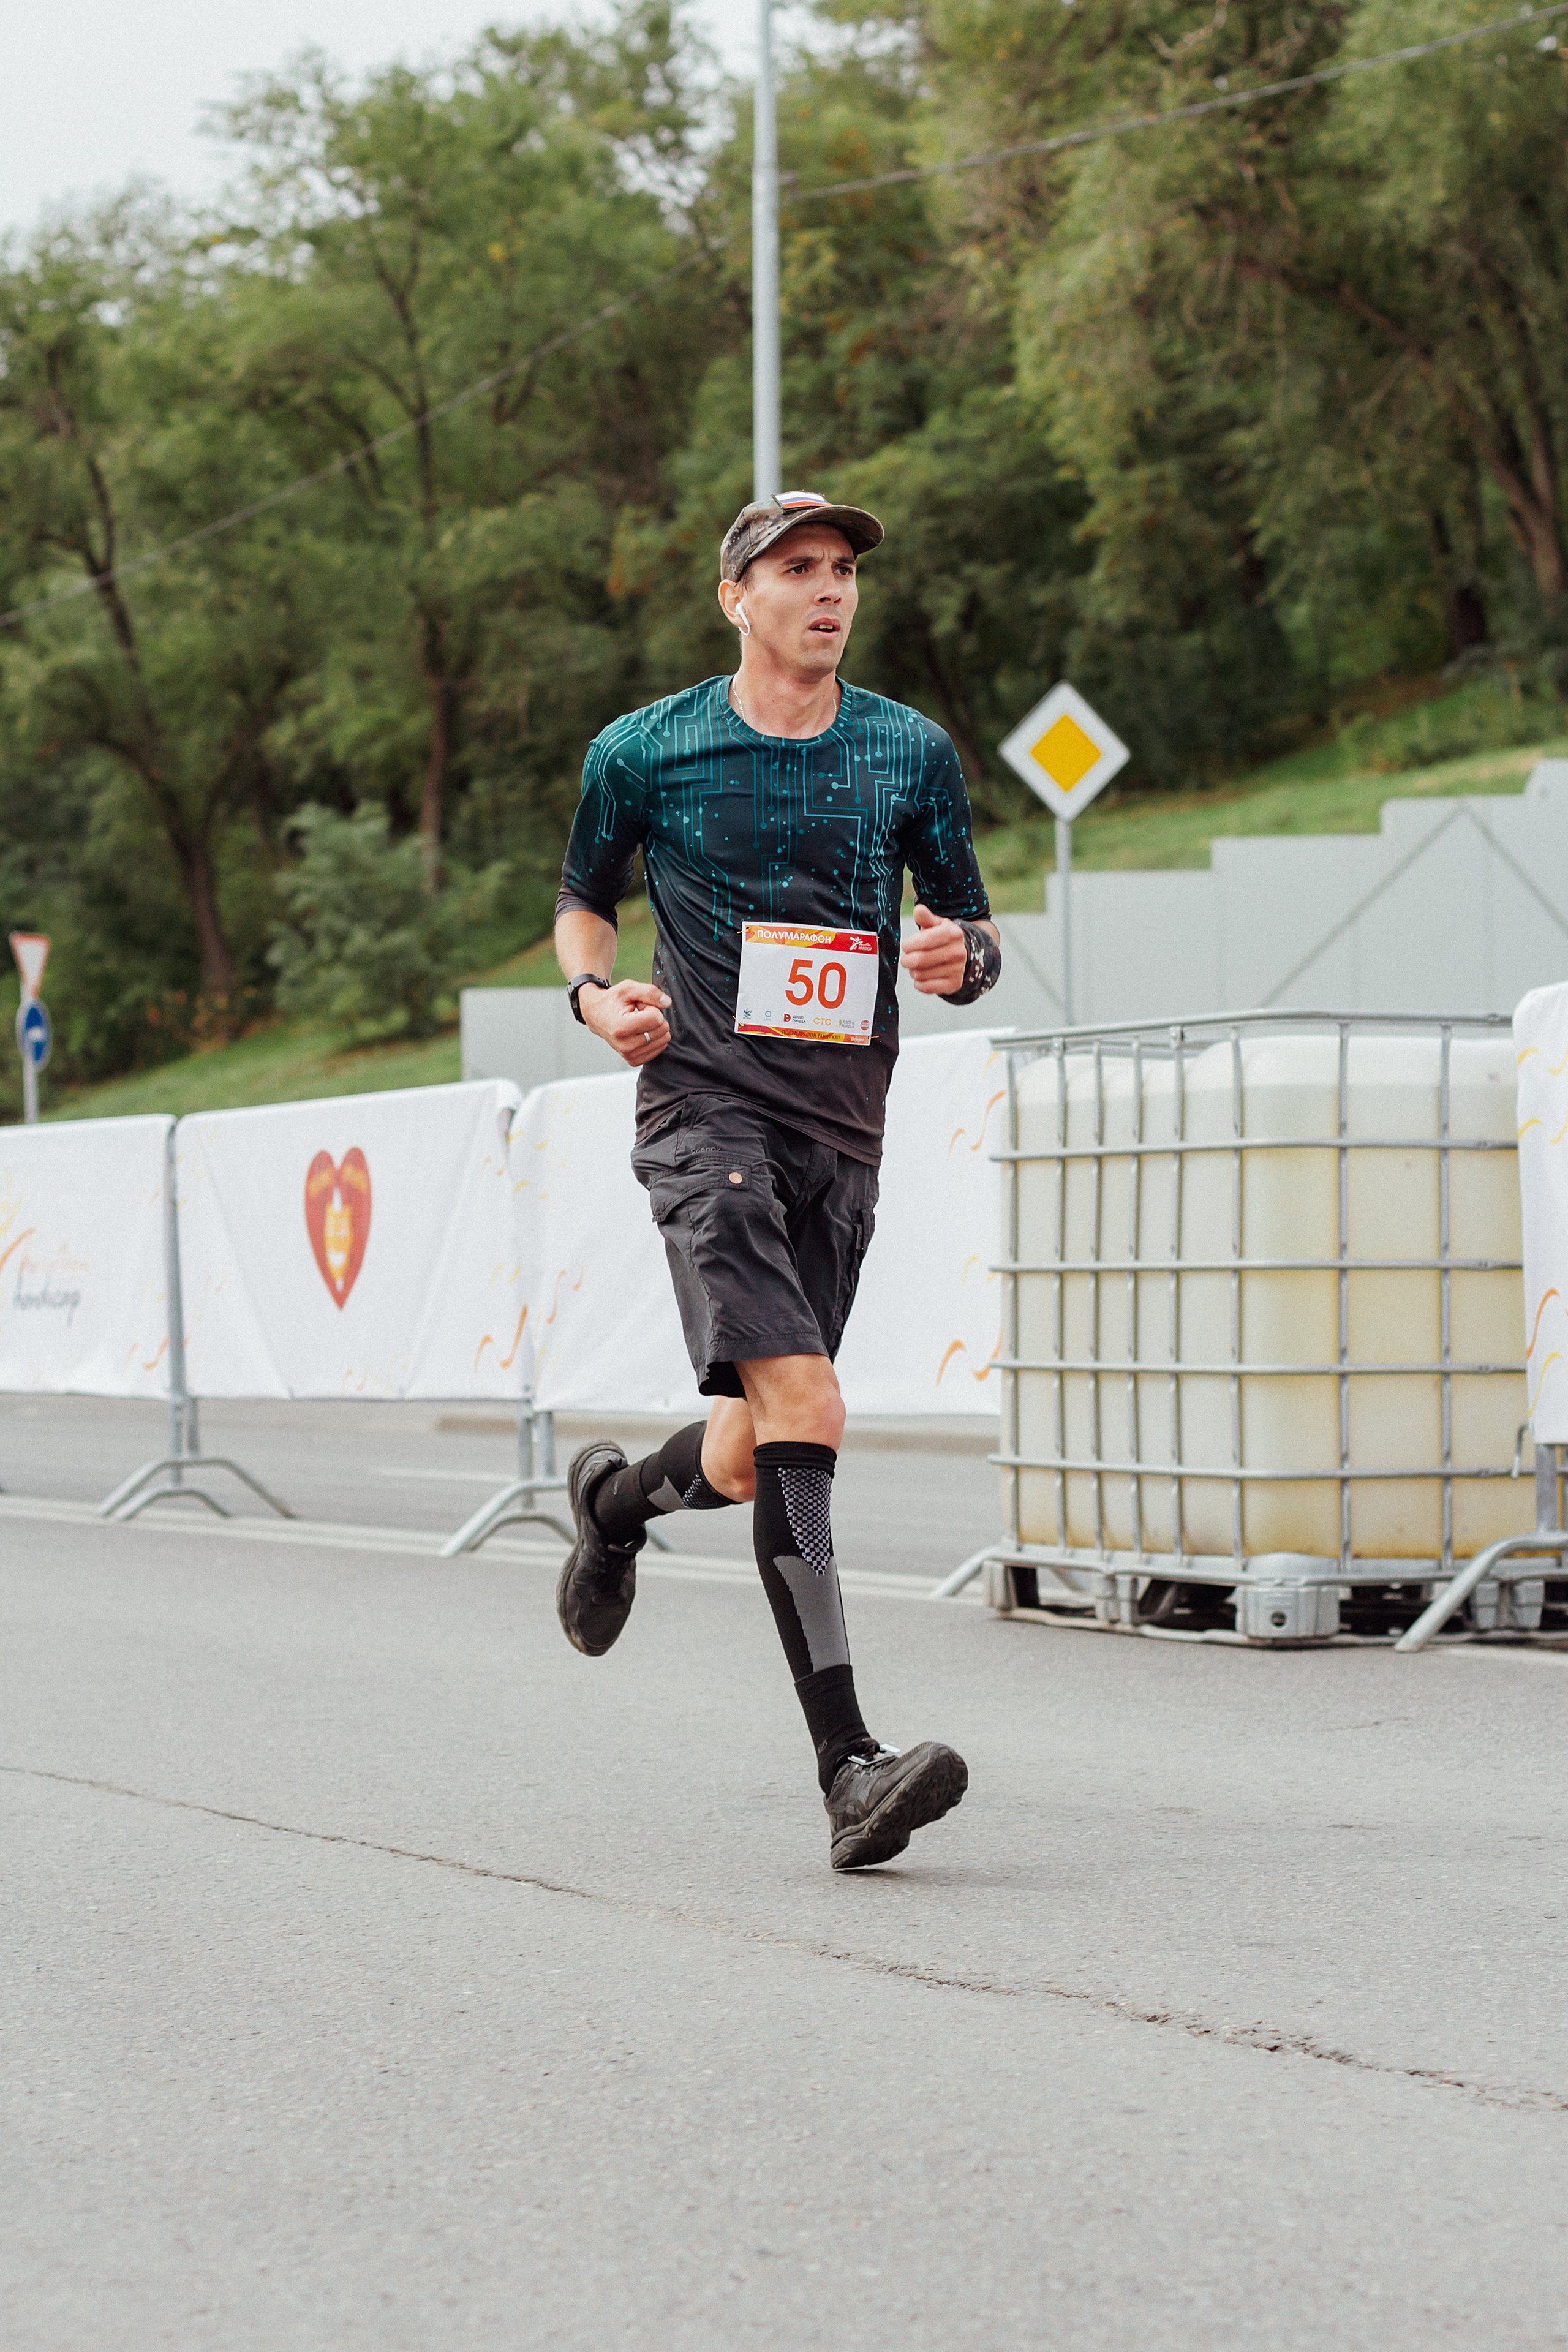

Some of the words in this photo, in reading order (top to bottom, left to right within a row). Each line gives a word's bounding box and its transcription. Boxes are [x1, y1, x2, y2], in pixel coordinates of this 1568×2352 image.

[757, 929, 831, 944] ПОЛУМАРАФОН
[785, 959, 846, 1009] 50
[813, 1017, 831, 1026] СТС
